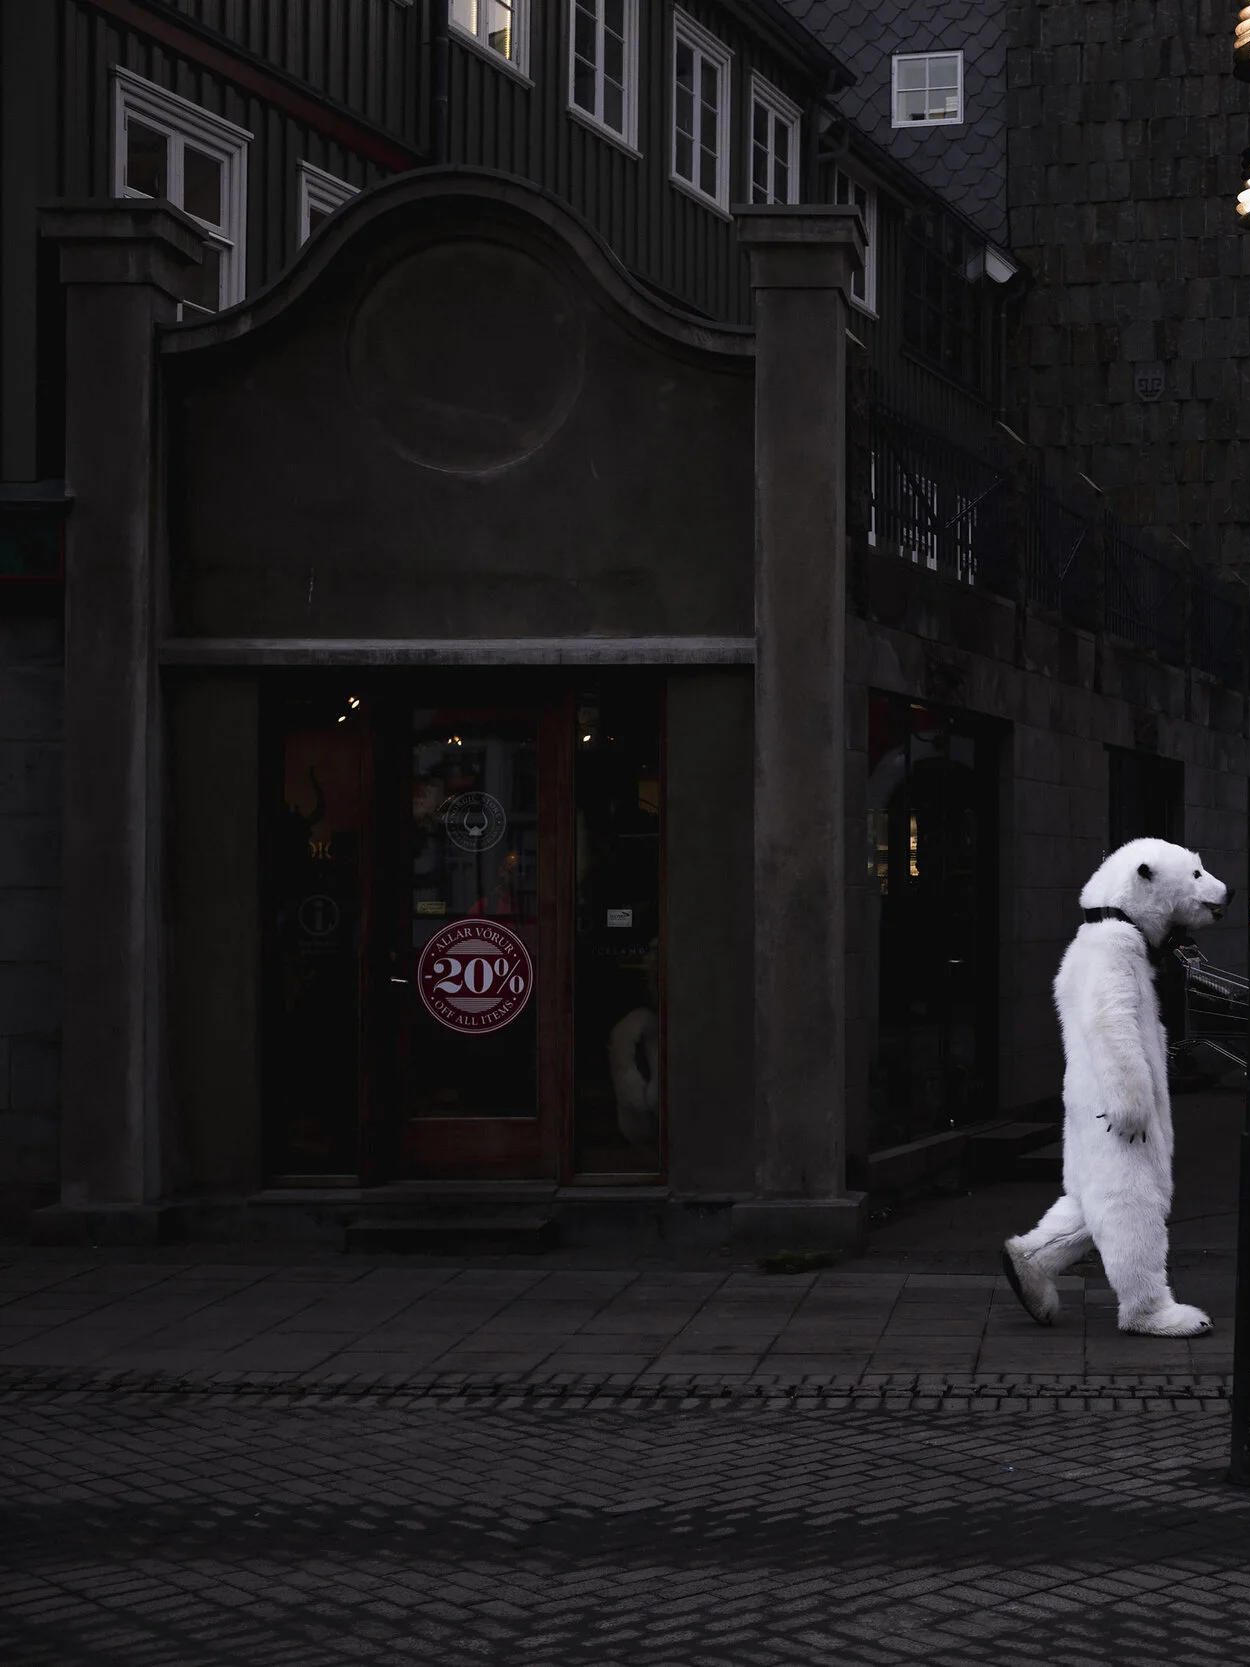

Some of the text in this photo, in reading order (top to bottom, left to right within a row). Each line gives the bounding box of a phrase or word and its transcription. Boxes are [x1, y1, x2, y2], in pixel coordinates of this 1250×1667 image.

[435, 927, 515, 954] ALLAR VÖRUR
[424, 957, 525, 995] -20%
[434, 999, 514, 1026] OFF ALL ITEMS
